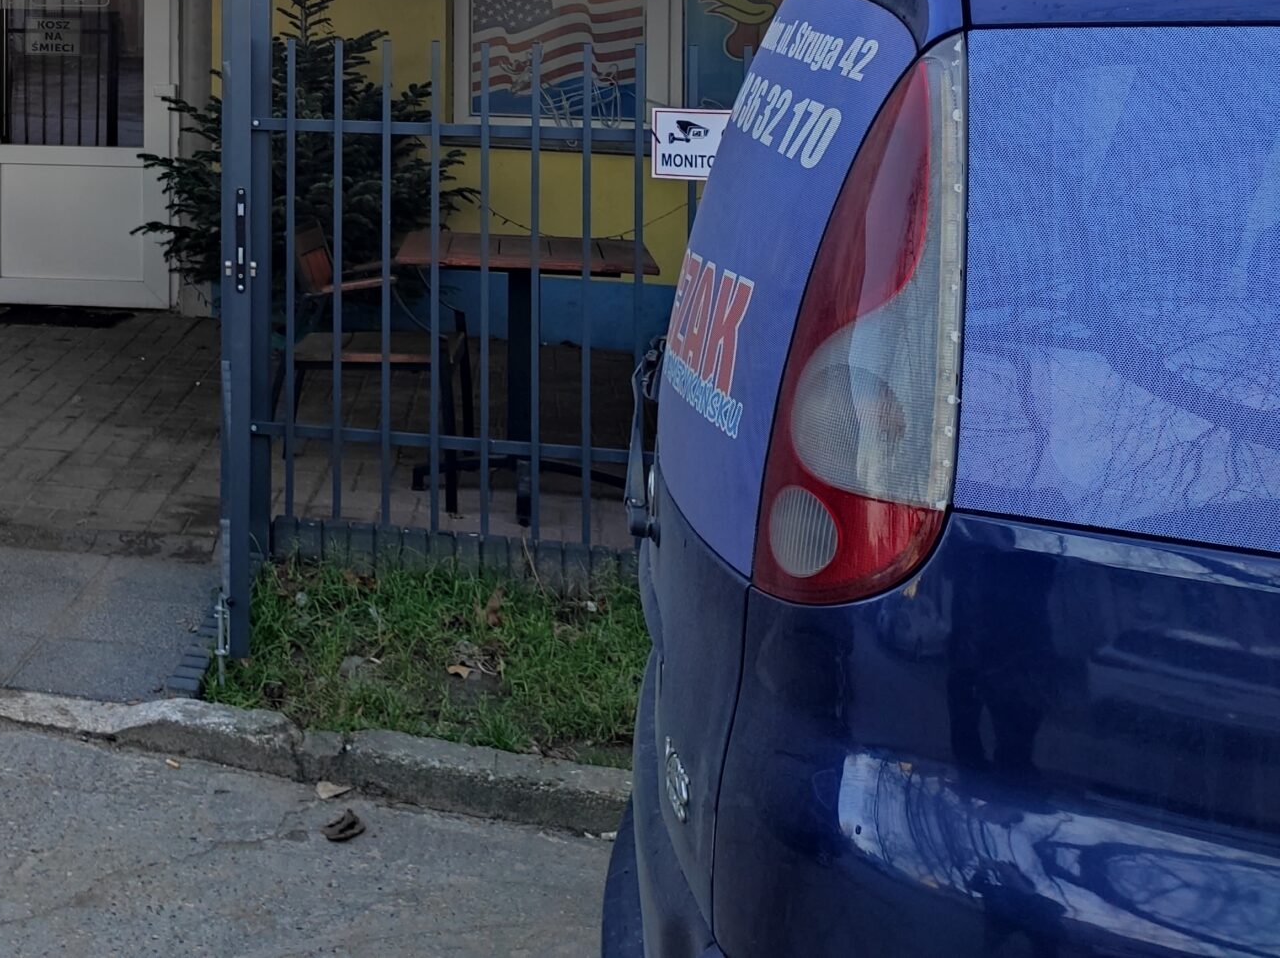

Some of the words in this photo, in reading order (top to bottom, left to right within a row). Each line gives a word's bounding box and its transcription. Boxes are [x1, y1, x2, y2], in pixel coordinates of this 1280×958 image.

[37, 20, 70, 30] KOSZ
[45, 31, 63, 41] NA
[31, 40, 74, 52] ŚMIECI
[838, 36, 879, 82] 42
[752, 84, 793, 147] 32
[777, 98, 842, 169] 170
